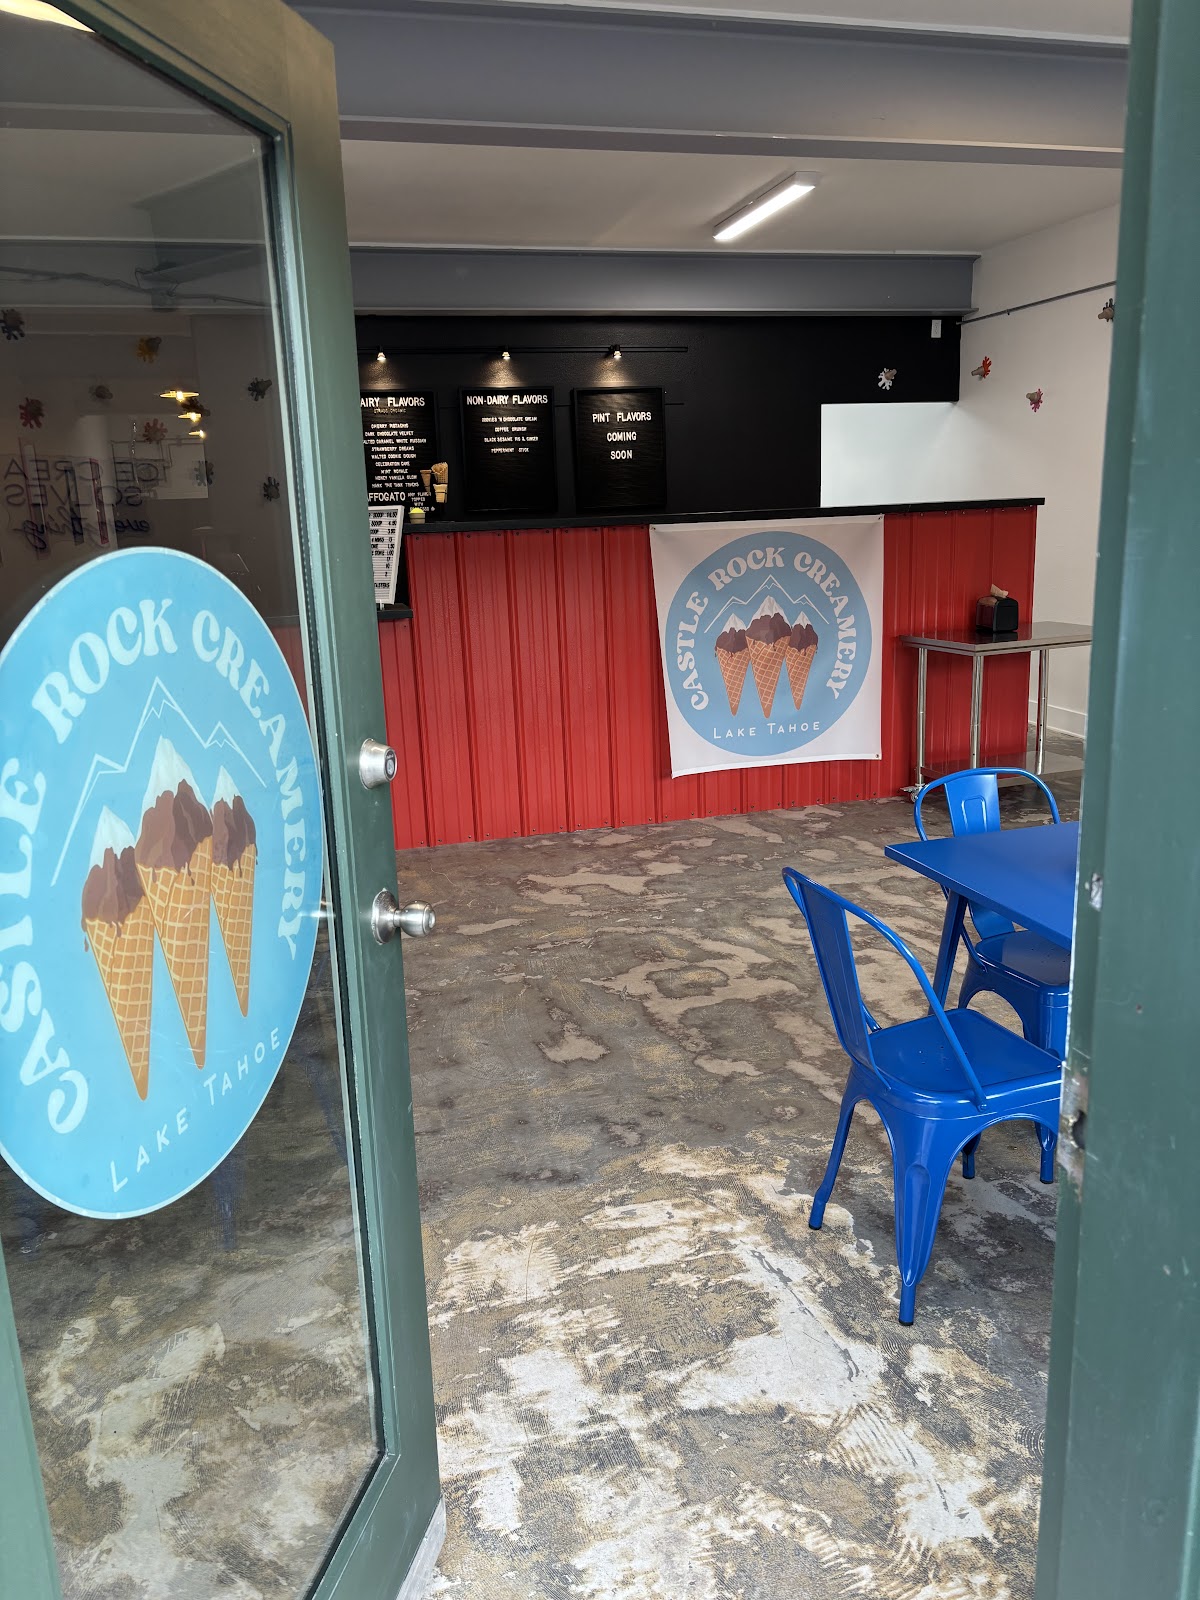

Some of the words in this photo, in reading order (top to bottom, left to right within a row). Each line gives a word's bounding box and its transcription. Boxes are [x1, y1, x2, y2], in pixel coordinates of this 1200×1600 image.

[360, 396, 380, 408] AIRY
[387, 396, 425, 407] FLAVORS
[466, 394, 509, 406] NON-DAIRY
[512, 394, 548, 405] FLAVORS
[592, 413, 610, 423] PINT
[616, 411, 652, 422] FLAVORS
[606, 431, 637, 442] COMING
[610, 450, 633, 460] SOON
[676, 591, 709, 711] CASTLE
[707, 547, 786, 591] ROCK
[793, 551, 857, 700] CREAMERY
[713, 727, 756, 739] LAKE
[766, 721, 820, 735] TAHOE
[32, 598, 179, 744] ROCK
[192, 609, 314, 961] CREAMERY
[109, 1111, 190, 1193] LAKE
[203, 1028, 281, 1104] TAHOE
